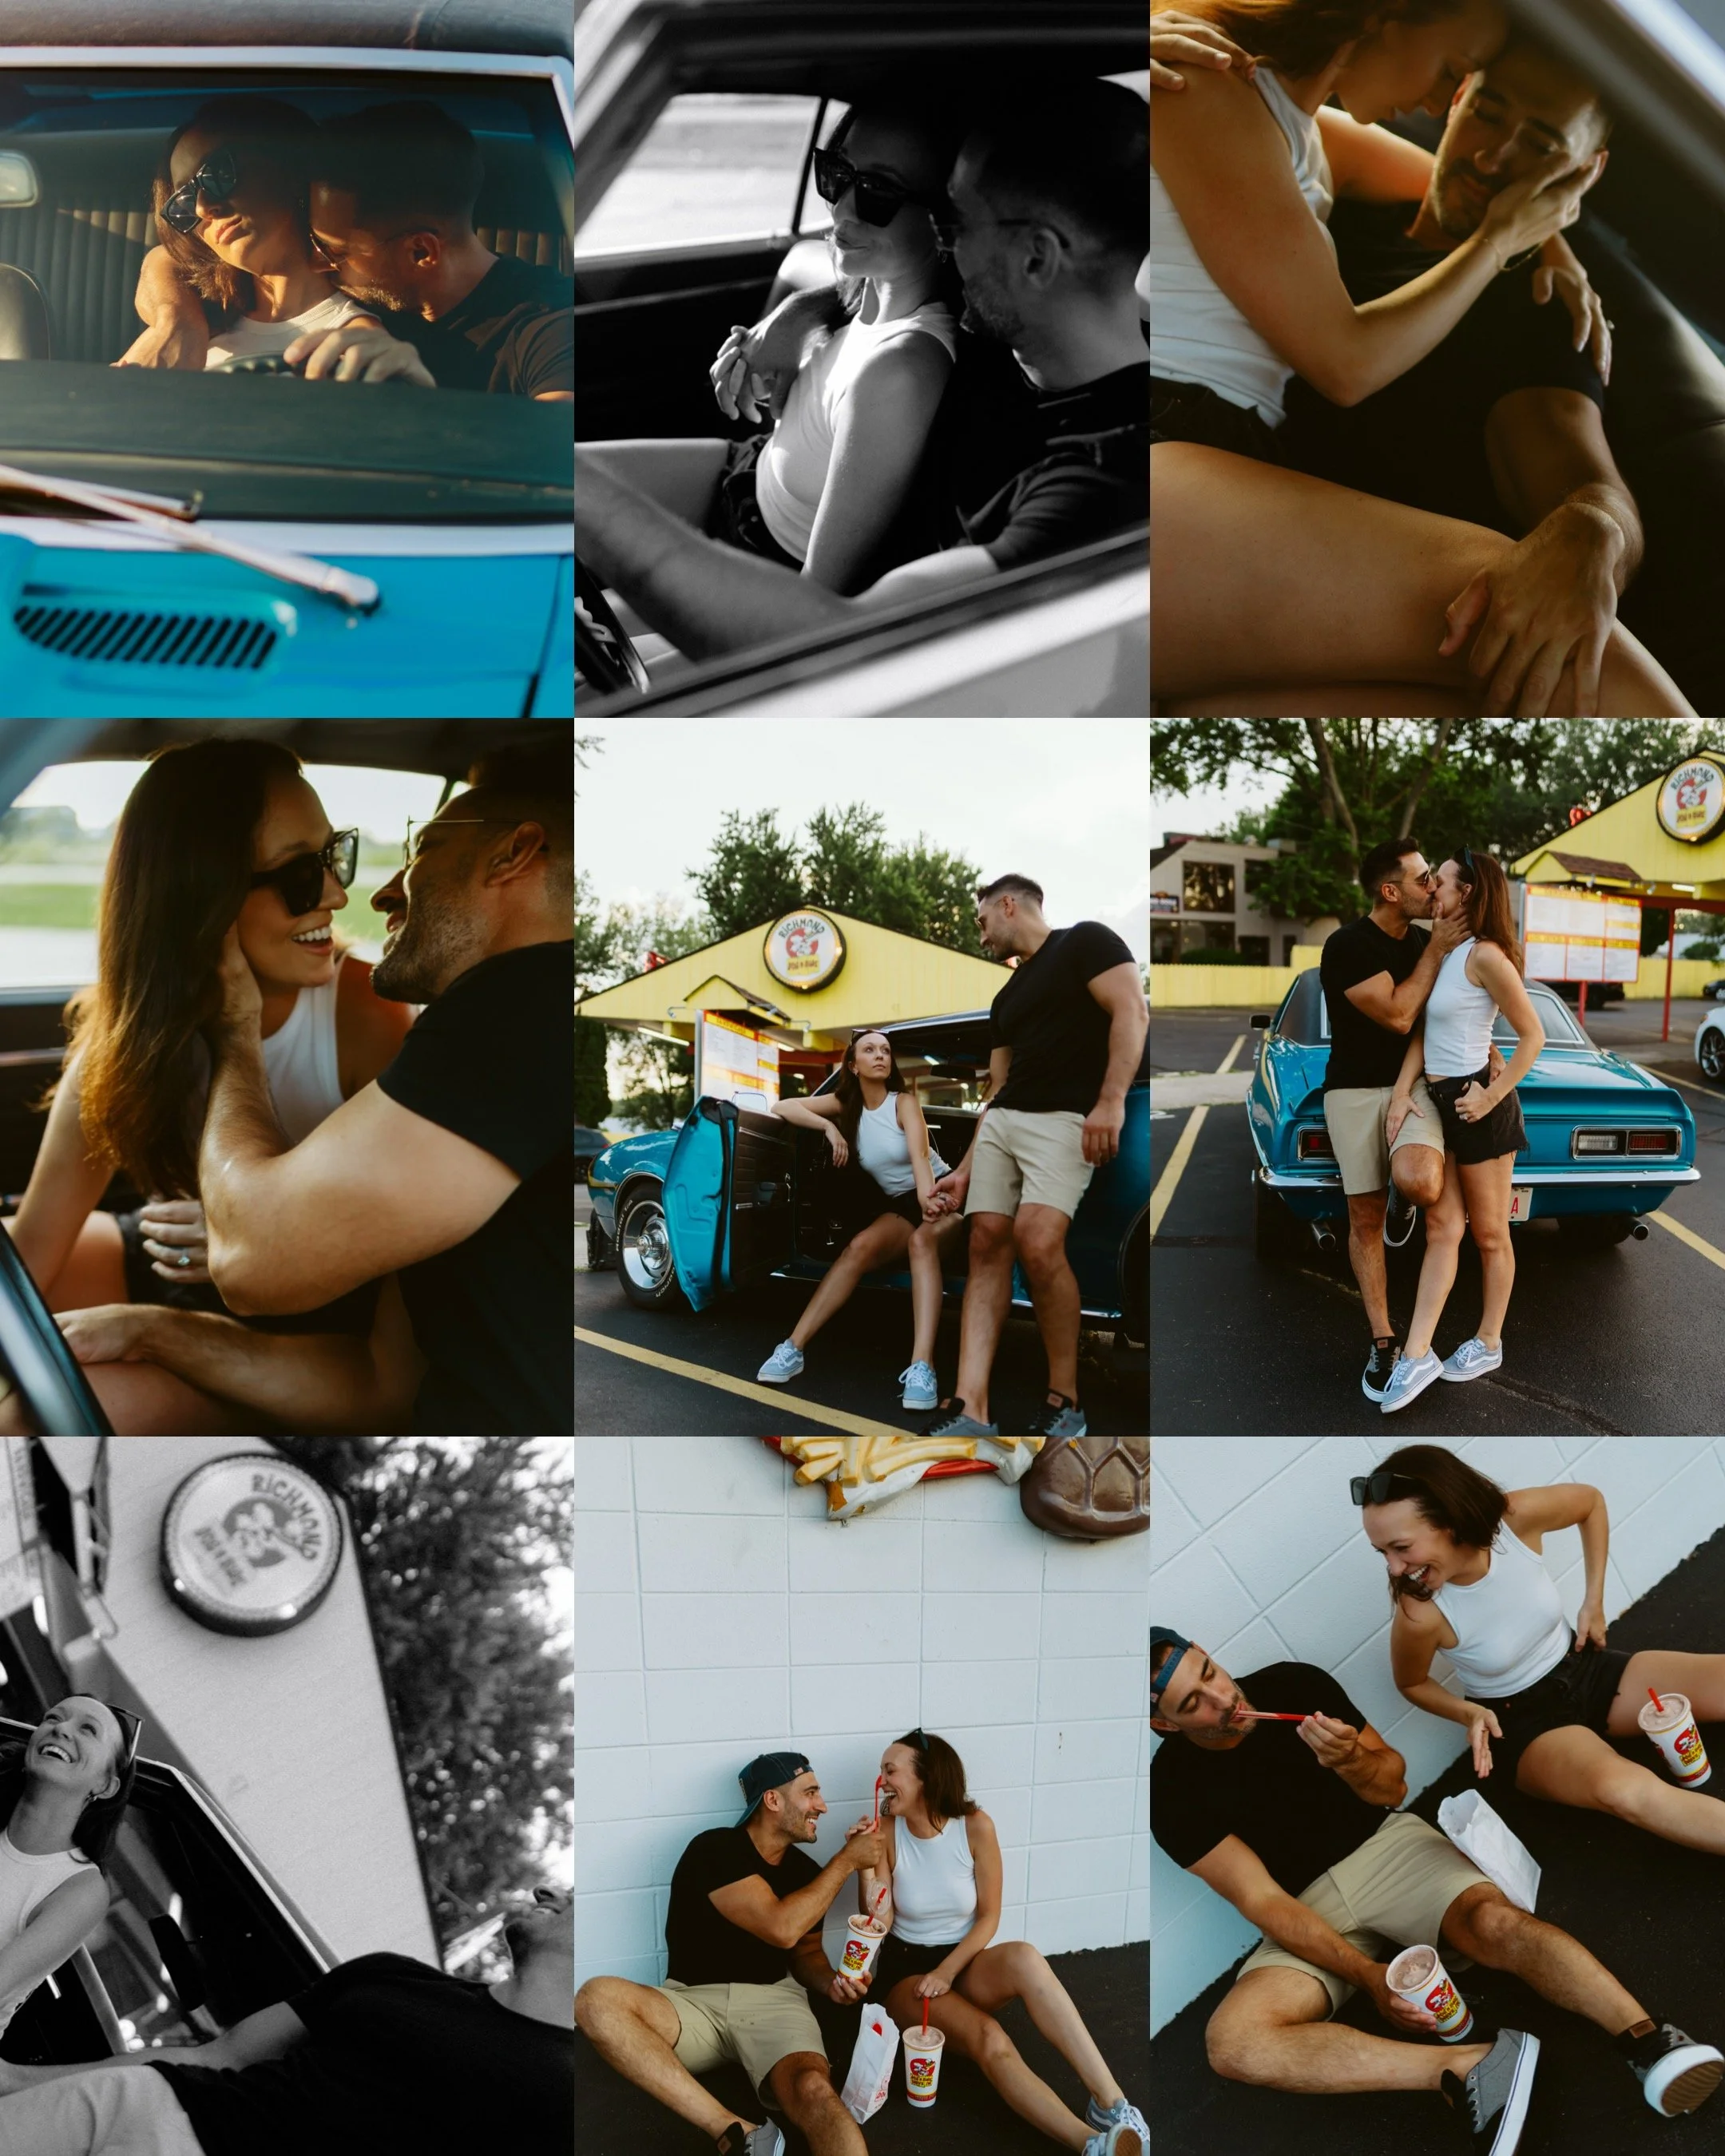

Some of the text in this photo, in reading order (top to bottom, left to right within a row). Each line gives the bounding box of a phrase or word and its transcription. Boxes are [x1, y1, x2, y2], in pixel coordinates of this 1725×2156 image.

[1671, 767, 1715, 790] RICHMOND
[778, 918, 825, 938] RICHMOND
[252, 1473, 321, 1561] RICHMOND
